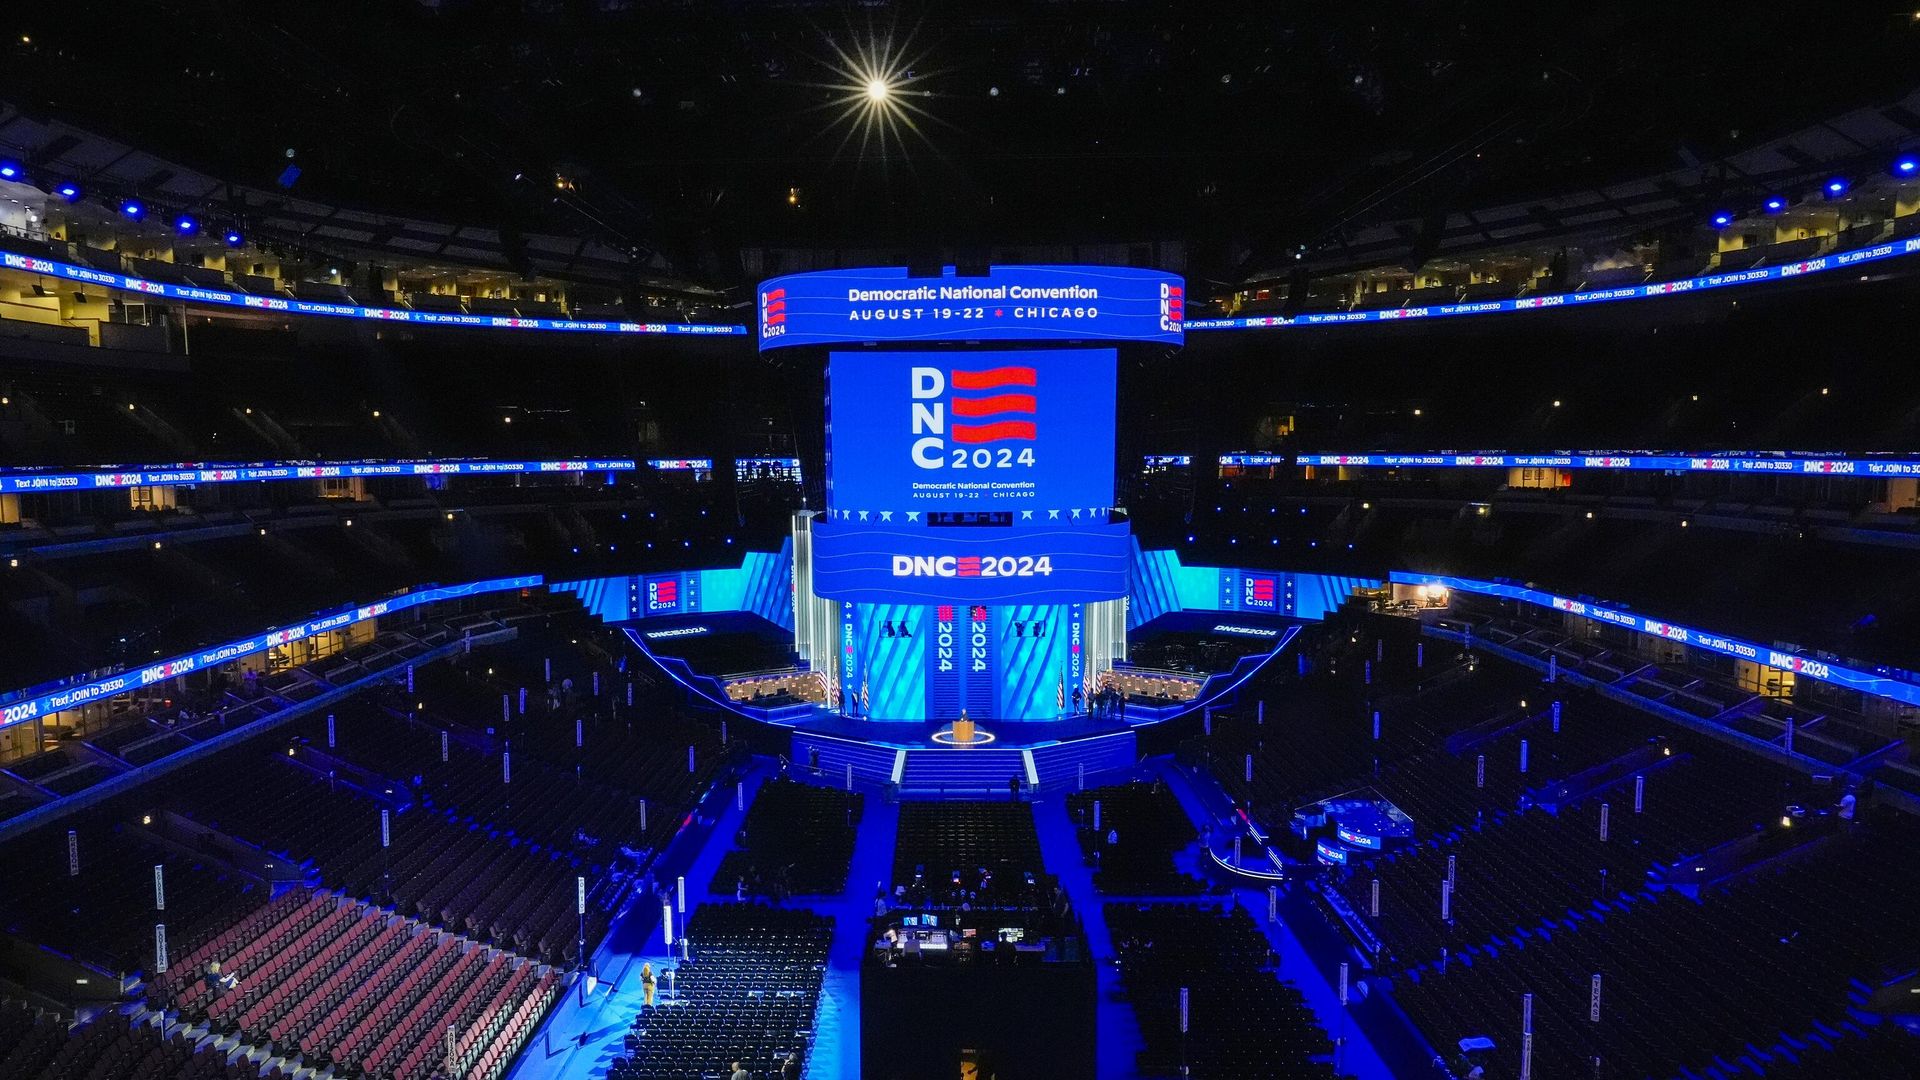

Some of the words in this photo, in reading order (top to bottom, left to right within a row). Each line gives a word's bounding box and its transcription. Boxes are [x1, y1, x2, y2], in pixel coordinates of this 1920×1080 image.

[849, 287, 934, 301] Democratic
[941, 286, 1003, 299] National
[1010, 285, 1097, 298] Convention
[850, 309, 923, 320] AUGUST
[934, 308, 983, 318] 19-22
[1015, 308, 1097, 317] CHICAGO
[952, 448, 1035, 468] 2024
[893, 556, 956, 576] DNC
[981, 557, 1052, 576] 2024
[939, 622, 952, 671] 2024
[972, 621, 986, 671] 2024
[4, 702, 37, 724] 2024
